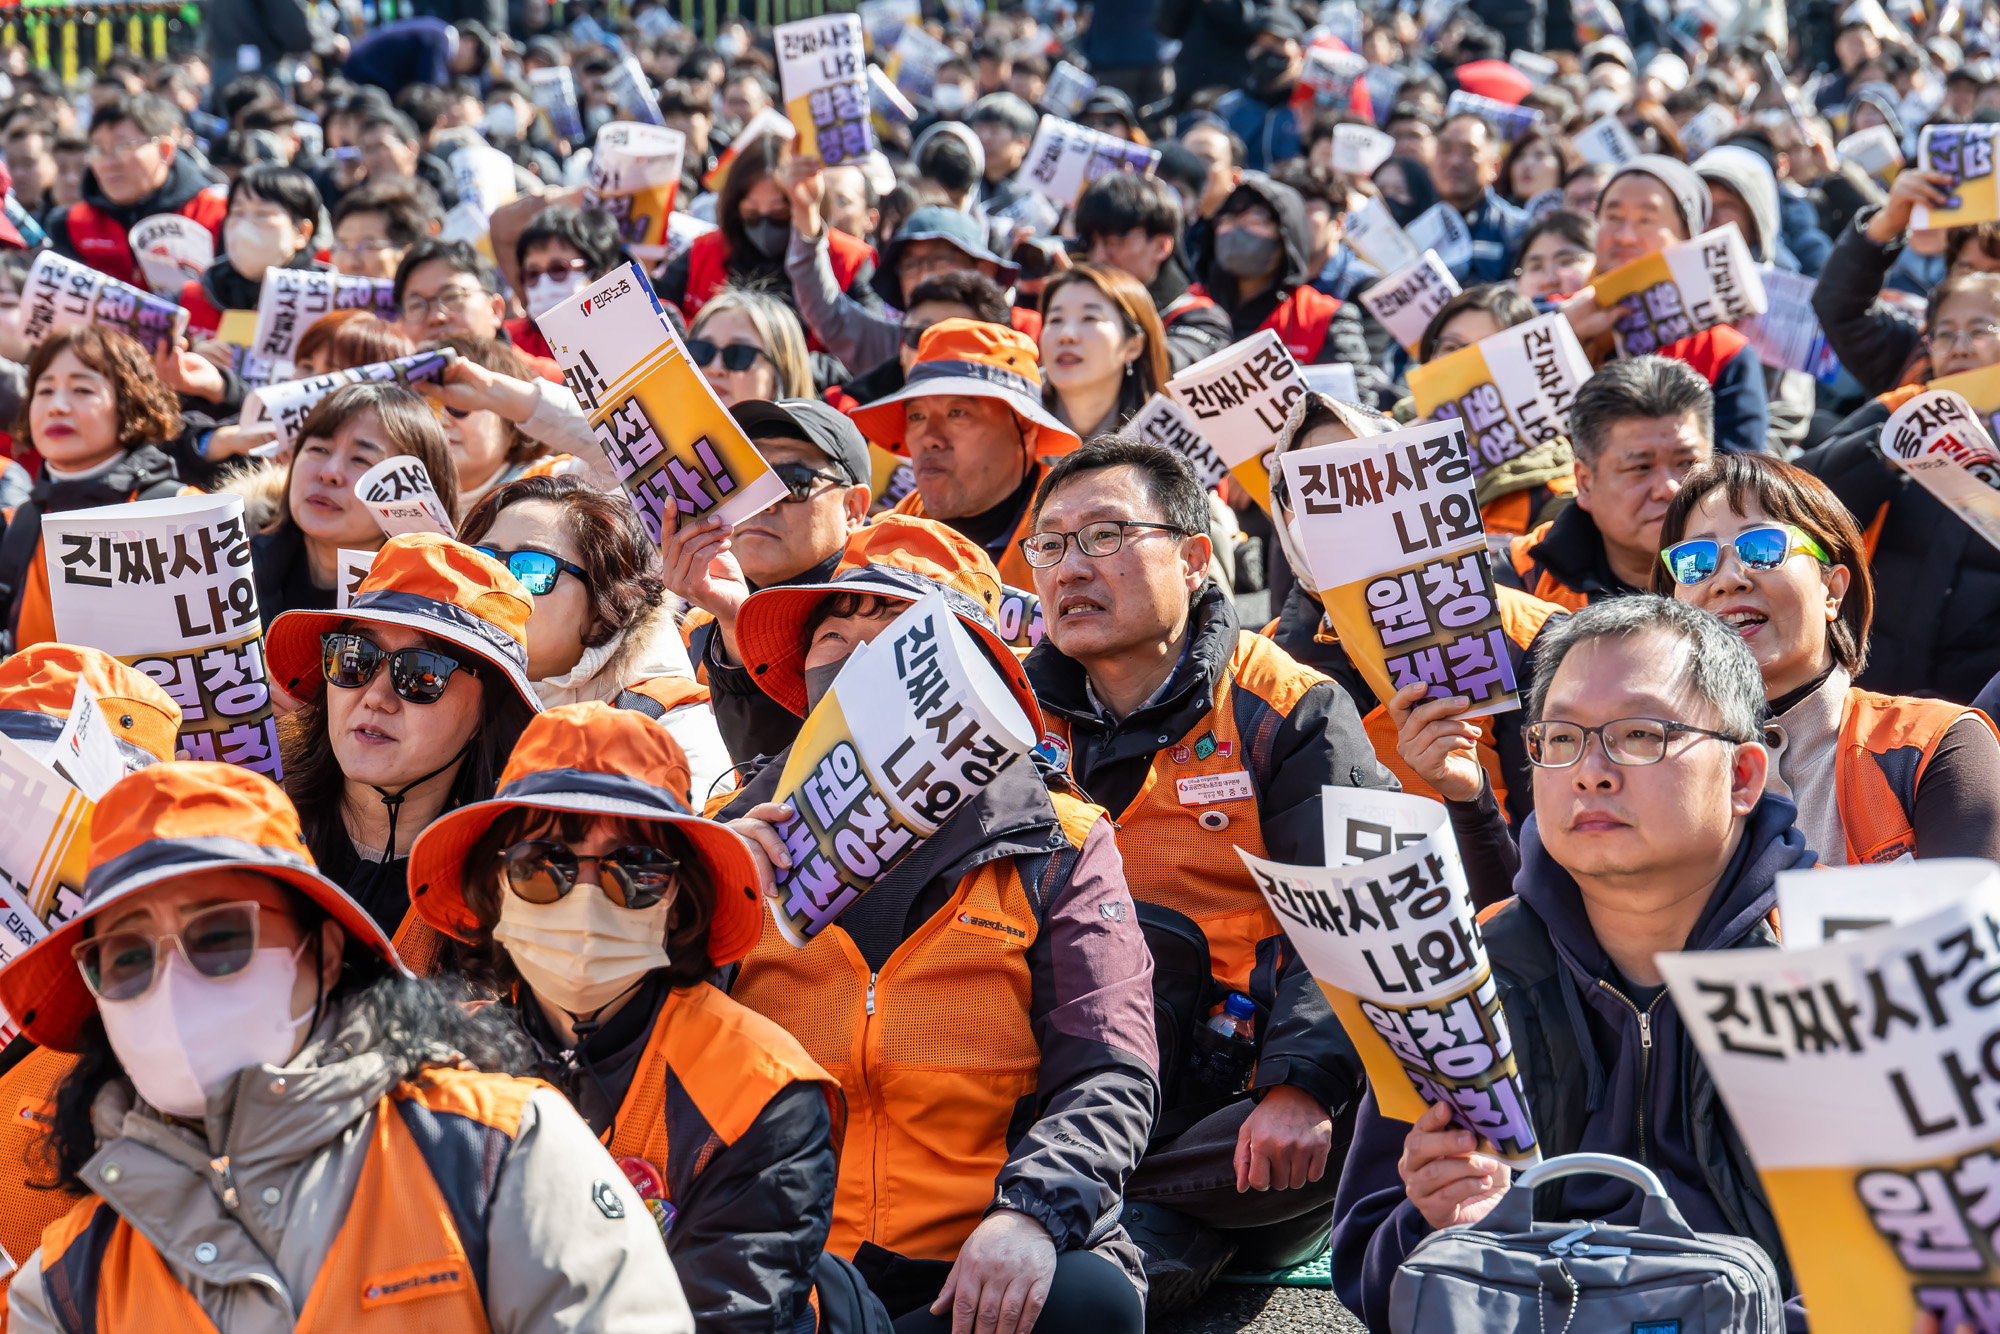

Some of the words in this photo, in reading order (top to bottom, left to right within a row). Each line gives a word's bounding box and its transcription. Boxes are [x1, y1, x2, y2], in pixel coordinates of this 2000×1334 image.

[593, 279, 631, 309] 민주노총
[1180, 341, 1295, 420] 진짜사장
[1521, 326, 1572, 418] 진짜사
[1145, 408, 1230, 478] 진짜사
[1299, 430, 1471, 515] 진짜사장
[60, 512, 251, 588] 진짜사장
[390, 508, 423, 518] 민주노총
[1392, 489, 1484, 554] 나와
[1366, 554, 1492, 648] 원청
[893, 614, 1020, 786] 진짜사장
[1254, 852, 1452, 937] 진짜사장
[1362, 916, 1478, 994] 나와
